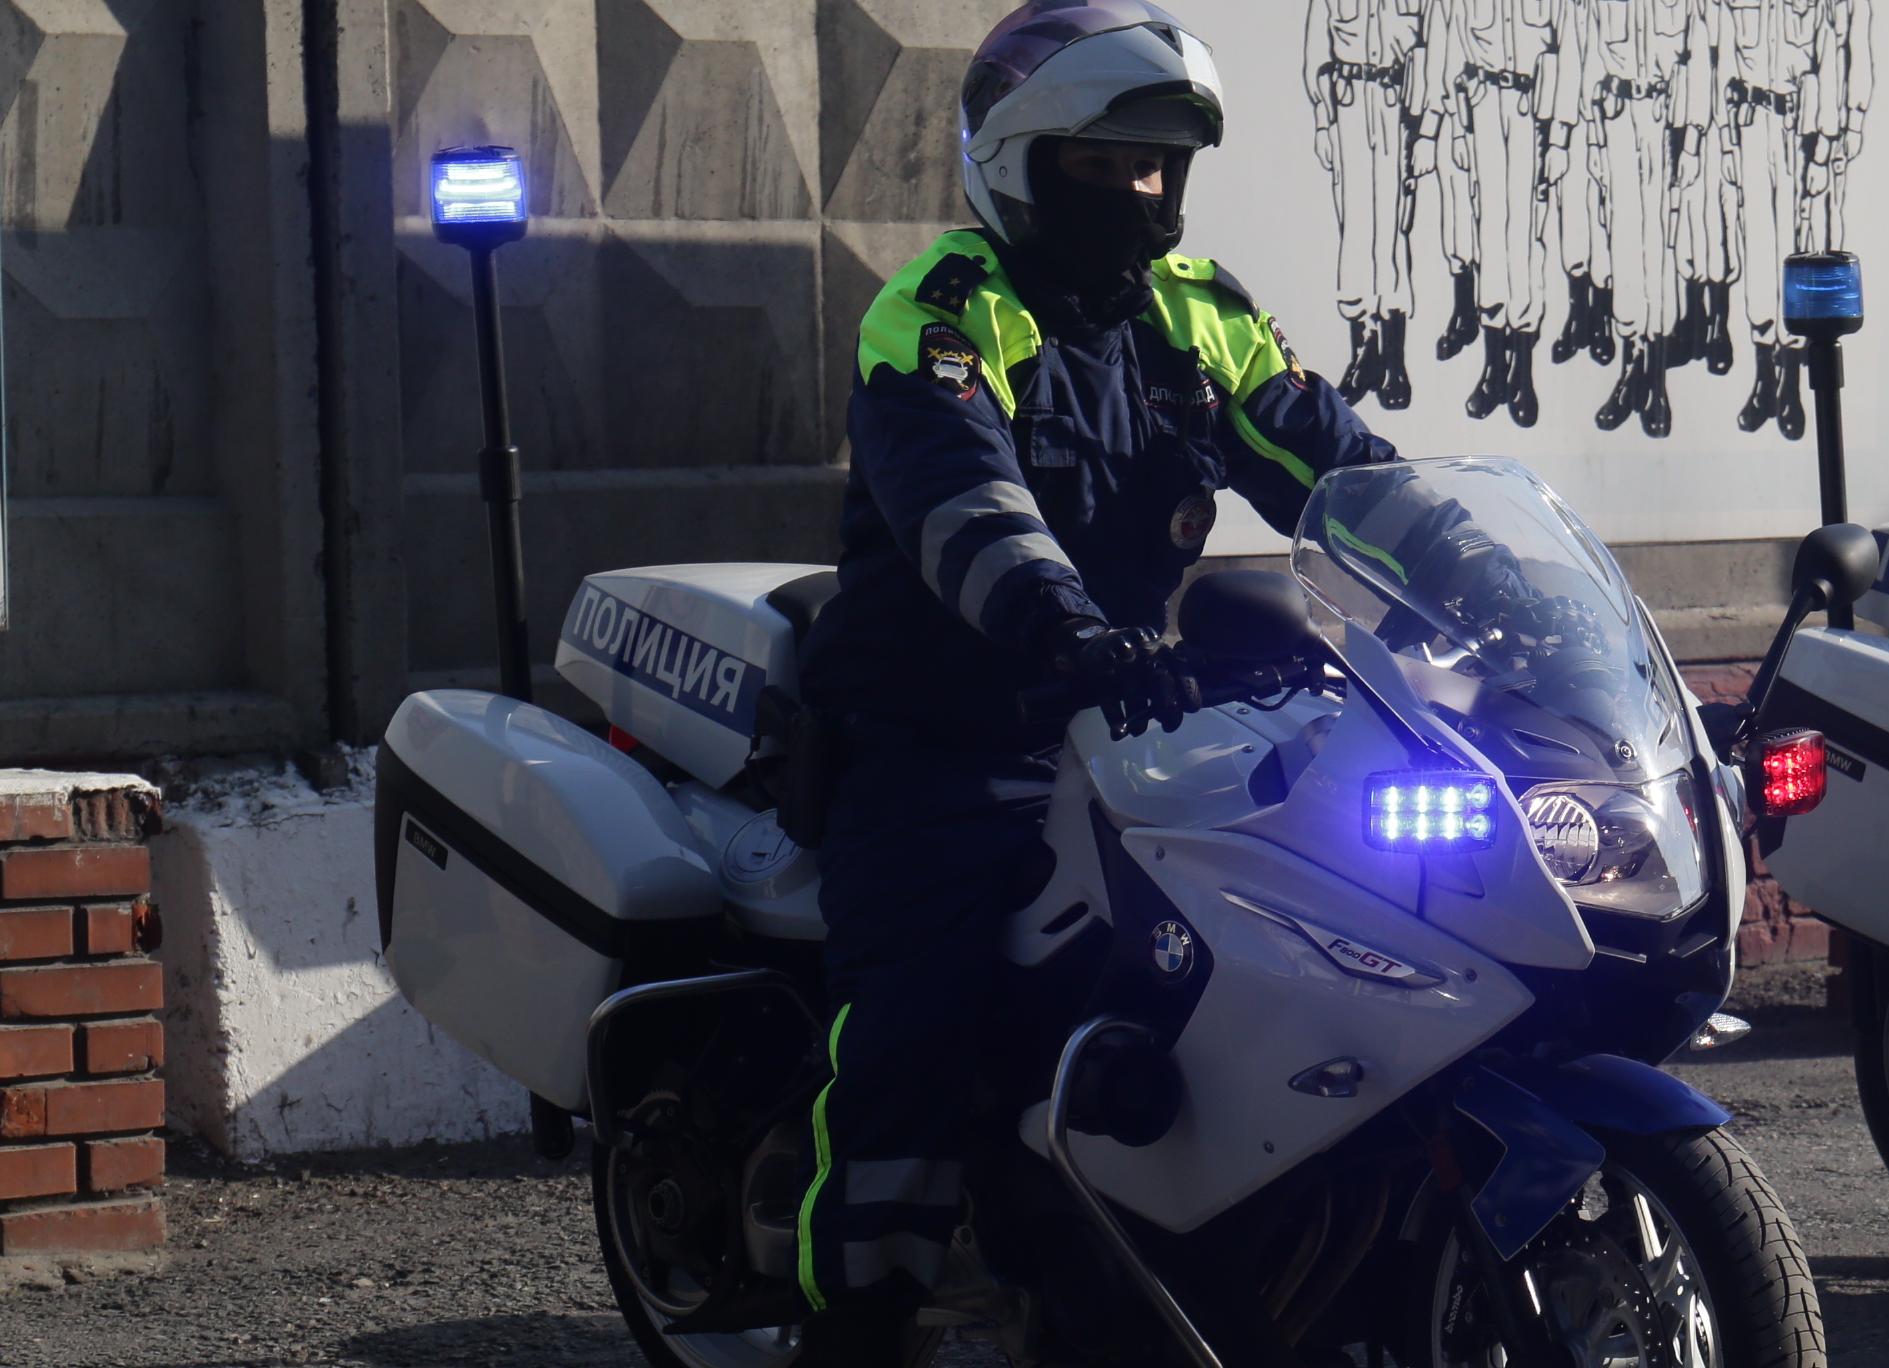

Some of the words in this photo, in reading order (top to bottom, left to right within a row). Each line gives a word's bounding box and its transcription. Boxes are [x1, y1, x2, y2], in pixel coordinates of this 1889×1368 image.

[573, 585, 747, 713] ПОЛИЦИЯ
[1825, 749, 1852, 771] BMW
[1327, 938, 1402, 973] F800GT
